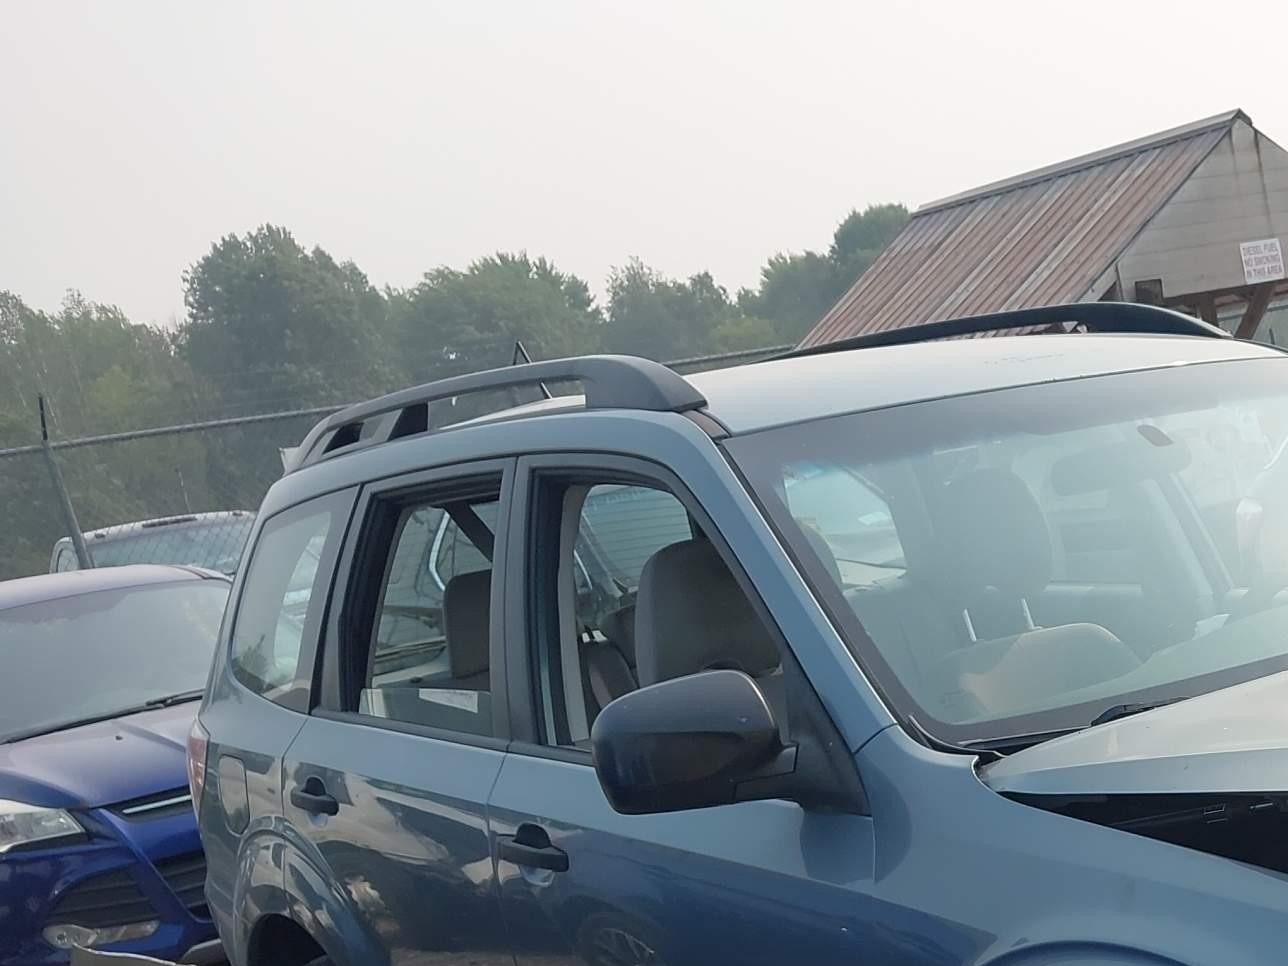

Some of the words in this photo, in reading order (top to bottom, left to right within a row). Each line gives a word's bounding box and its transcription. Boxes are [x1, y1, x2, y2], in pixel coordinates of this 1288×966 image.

[1244, 256, 1253, 267] NO
[1254, 253, 1280, 266] SMOKING
[1252, 267, 1265, 277] THIS
[1267, 264, 1282, 275] AREA
